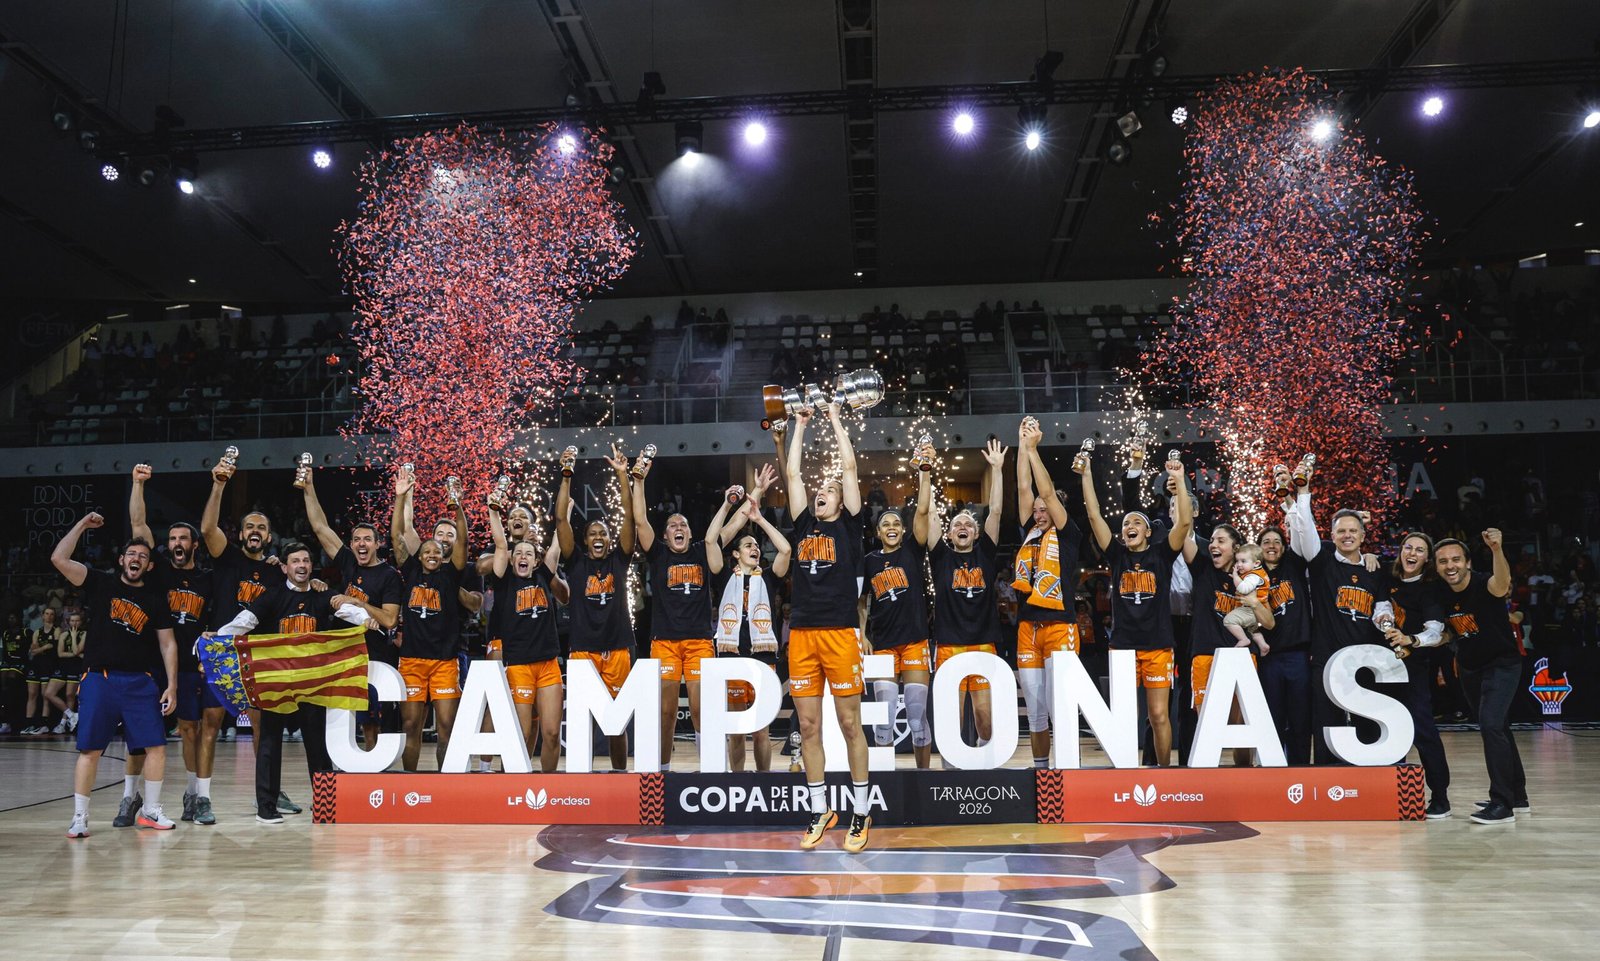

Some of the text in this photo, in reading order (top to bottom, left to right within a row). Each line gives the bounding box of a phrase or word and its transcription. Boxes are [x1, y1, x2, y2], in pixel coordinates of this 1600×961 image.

[33, 484, 94, 504] DONDE
[21, 507, 76, 527] TODO
[326, 645, 1414, 773] CAMPEONAS
[508, 795, 590, 806] LF endesa
[679, 784, 888, 813] COPA DE LA RINA
[930, 785, 1021, 802] TARRAGONA
[1114, 791, 1204, 803] LF endesa
[959, 803, 992, 815] 2026
